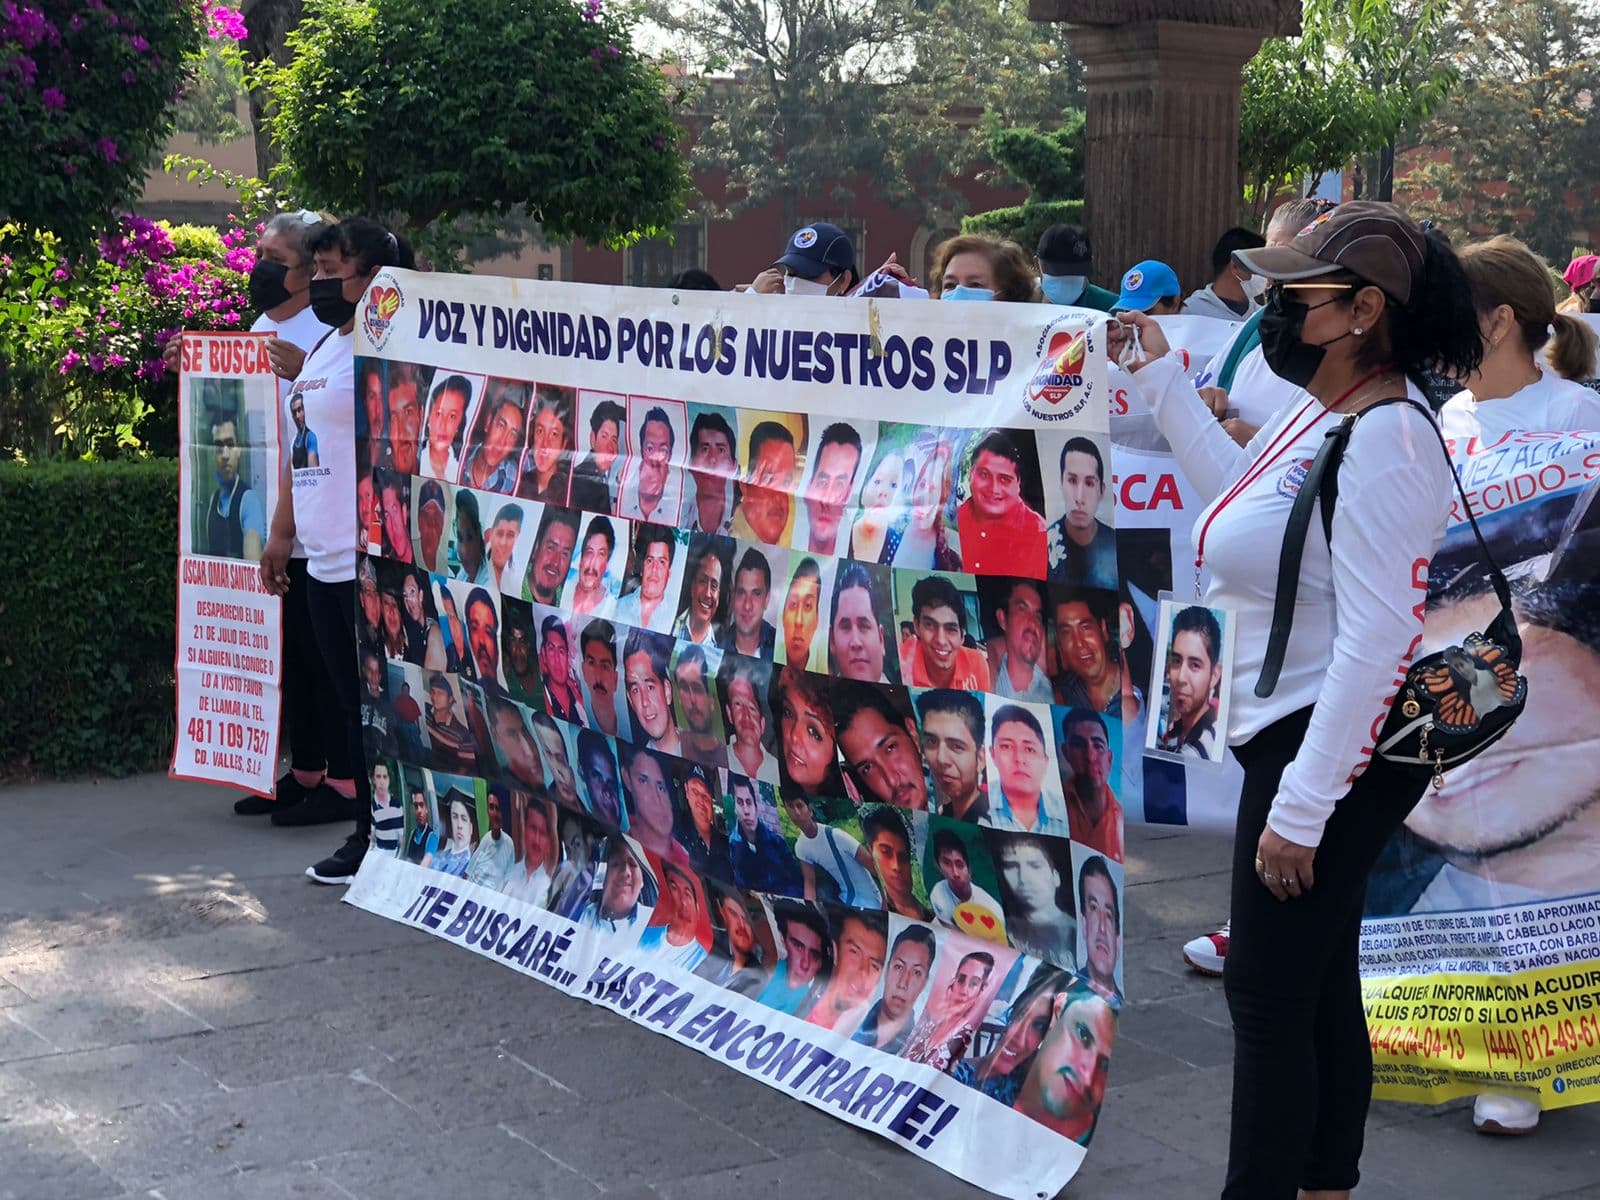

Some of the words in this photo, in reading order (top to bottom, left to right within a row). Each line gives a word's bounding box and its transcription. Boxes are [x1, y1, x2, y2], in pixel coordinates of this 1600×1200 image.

[182, 338, 202, 373] SE
[209, 339, 271, 374] BUSCA
[418, 298, 467, 345] VOZ
[470, 304, 487, 346] Y
[492, 305, 612, 362] DIGNIDAD
[617, 317, 674, 370] POR
[679, 322, 738, 376] LOS
[744, 326, 936, 391] NUESTROS
[943, 338, 1012, 396] SLP
[1032, 409, 1074, 422] NUESTROS
[183, 559, 207, 586] OSCAR
[208, 561, 230, 589] OMAR
[230, 564, 256, 592] SANTOS
[197, 601, 243, 621] DESAPARECIO
[245, 607, 253, 623] EL
[253, 609, 264, 625] DIA
[194, 625, 203, 639] 21
[206, 625, 215, 641] DE
[218, 627, 237, 644] JULIO
[239, 630, 251, 647] DEL
[252, 633, 268, 650] 2010
[188, 647, 196, 662] SI
[198, 649, 231, 667] ALGUIEN
[233, 653, 240, 668] LO
[241, 655, 267, 674] CONOCE
[269, 660, 273, 675] O
[202, 672, 211, 688] LO
[213, 675, 218, 689] A
[221, 675, 242, 692] VISTO
[244, 678, 263, 697] FAVOR
[199, 696, 209, 711] DE
[211, 698, 240, 716] LLAMAR
[242, 702, 250, 718] AL
[252, 704, 264, 721] TEL.
[188, 717, 212, 743] 481
[218, 722, 243, 749] 109
[246, 727, 269, 756] 7521
[194, 749, 209, 765] CD.
[1361, 939, 1393, 951] DELGADA
[1393, 937, 1414, 949] CARA
[1450, 932, 1475, 944] FRENTE
[1478, 931, 1504, 943] AMPLIA
[1506, 922, 1559, 941] CABELLO
[1561, 916, 1595, 932] LACIO
[1412, 920, 1424, 932] DE
[1425, 918, 1454, 930] OCTUBRE
[1455, 917, 1470, 929] DEL
[1488, 913, 1512, 927] MIDE
[1514, 910, 1535, 923] 1.80
[1567, 931, 1600, 947] BARB
[1513, 959, 1526, 971] 34
[1528, 953, 1560, 969] AÑOS
[1564, 946, 1600, 962] NACIO
[1432, 983, 1529, 1002] INFORMACION
[1534, 971, 1600, 997] ACUDIR
[1376, 1005, 1409, 1020] LUIS
[1412, 1004, 1462, 1021] POTOSI
[1464, 1006, 1474, 1023] O
[1478, 1007, 1492, 1024] SI
[1496, 1007, 1518, 1024] LO
[1521, 1000, 1559, 1022] HAS
[582, 957, 695, 1030] HASTA
[677, 1003, 960, 1149] ENCONTRARTE!
[1482, 1029, 1523, 1069] (444)
[1494, 1071, 1512, 1081] DEL
[1514, 1067, 1551, 1082] ESTADO
